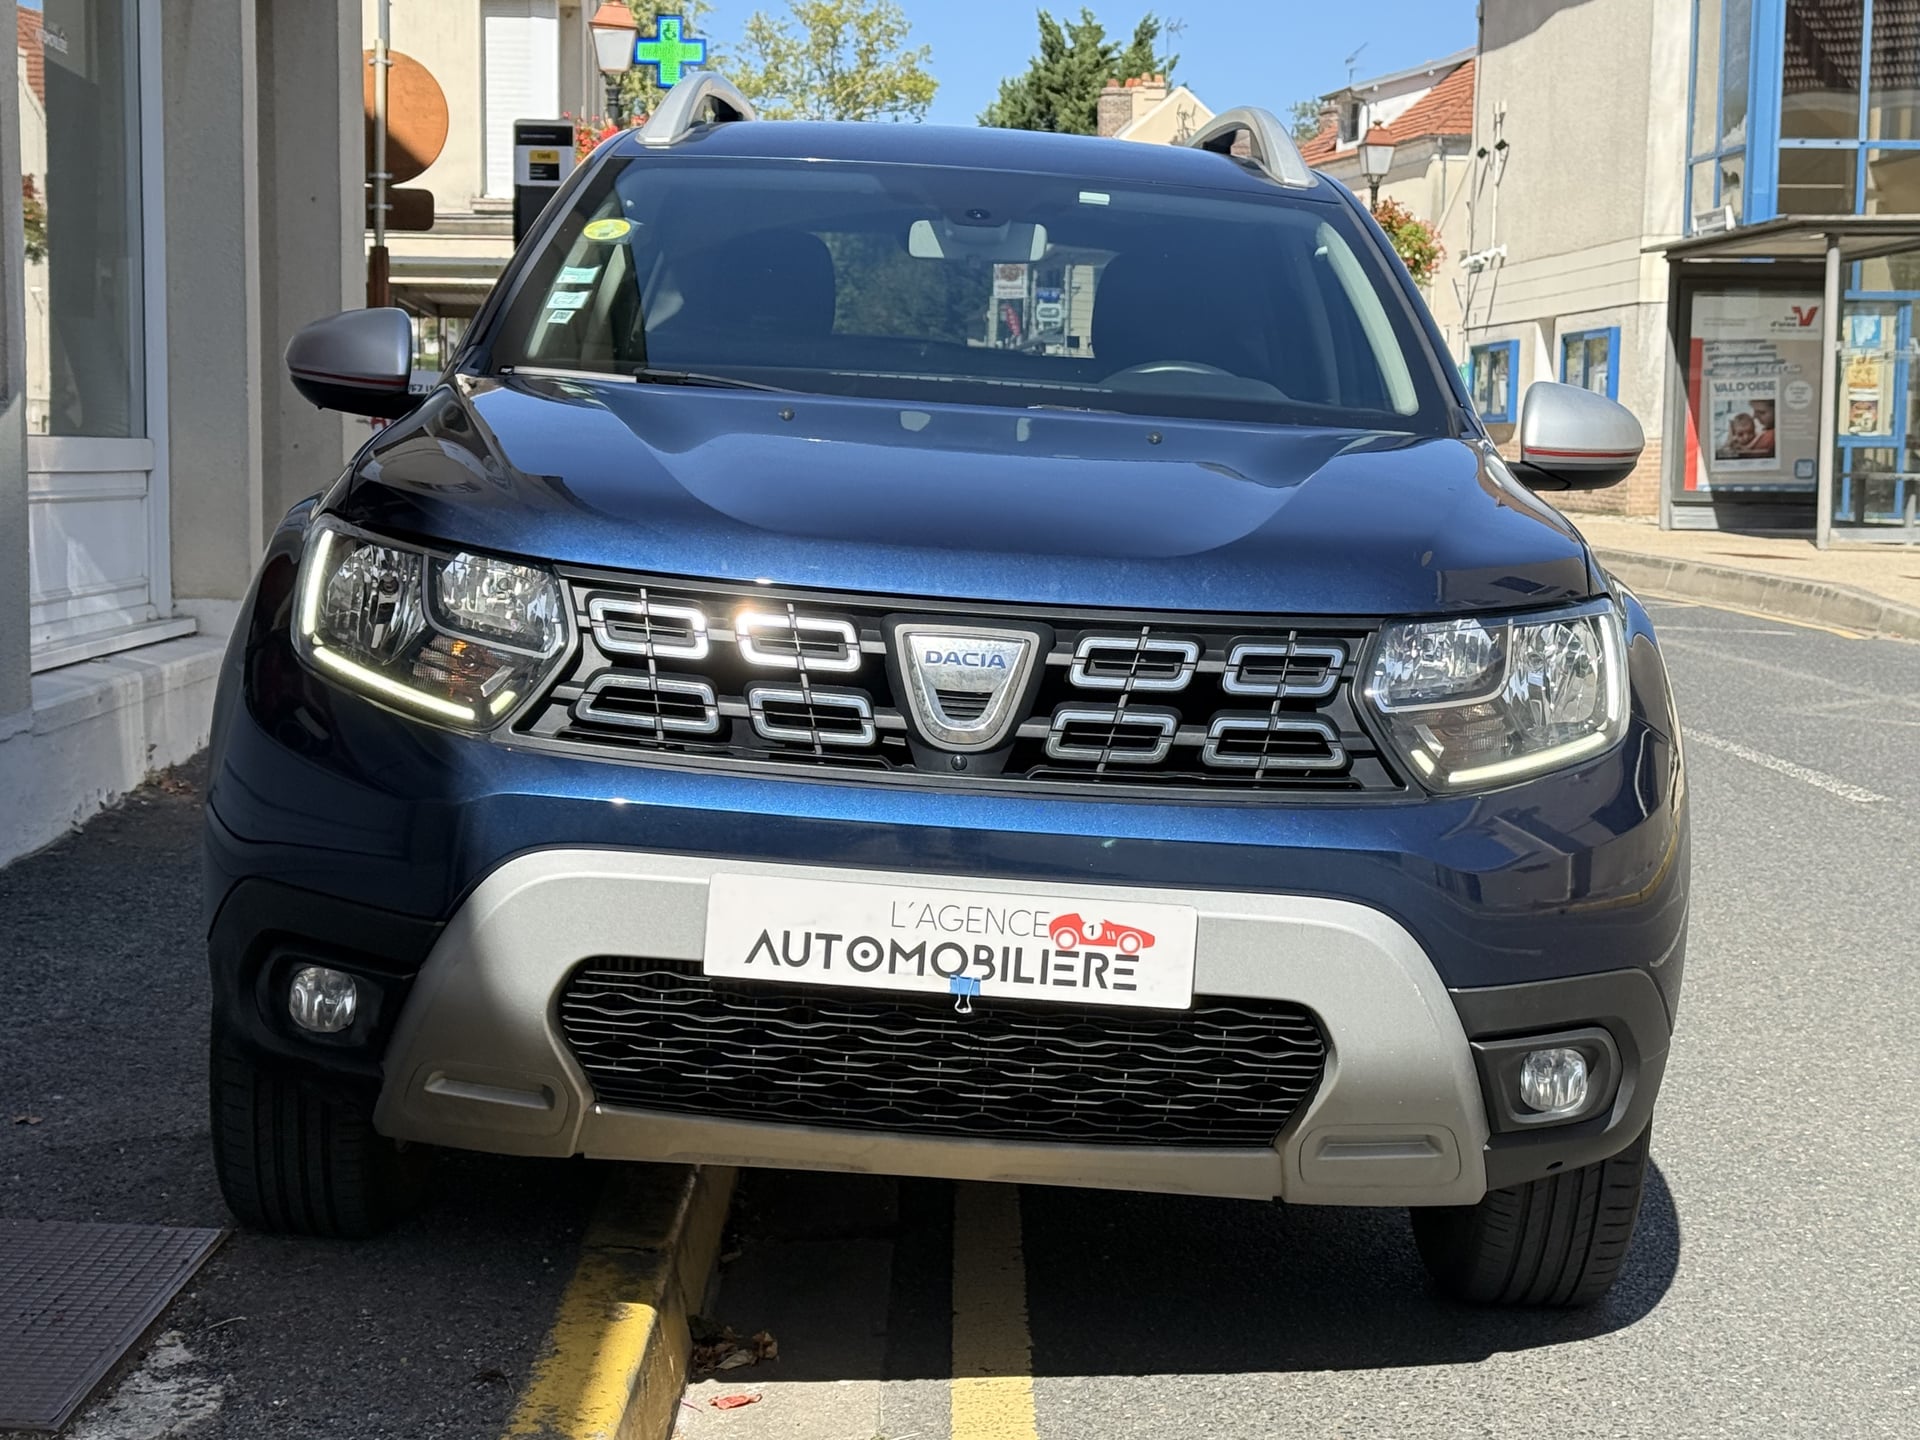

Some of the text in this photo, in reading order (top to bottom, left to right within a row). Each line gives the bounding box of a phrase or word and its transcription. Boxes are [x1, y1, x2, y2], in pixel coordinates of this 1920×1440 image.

[925, 650, 1006, 669] DACIA
[891, 900, 1050, 938] L'AGENCE
[1088, 924, 1096, 937] 1
[744, 928, 1140, 991] AUTOMOBILIERE
